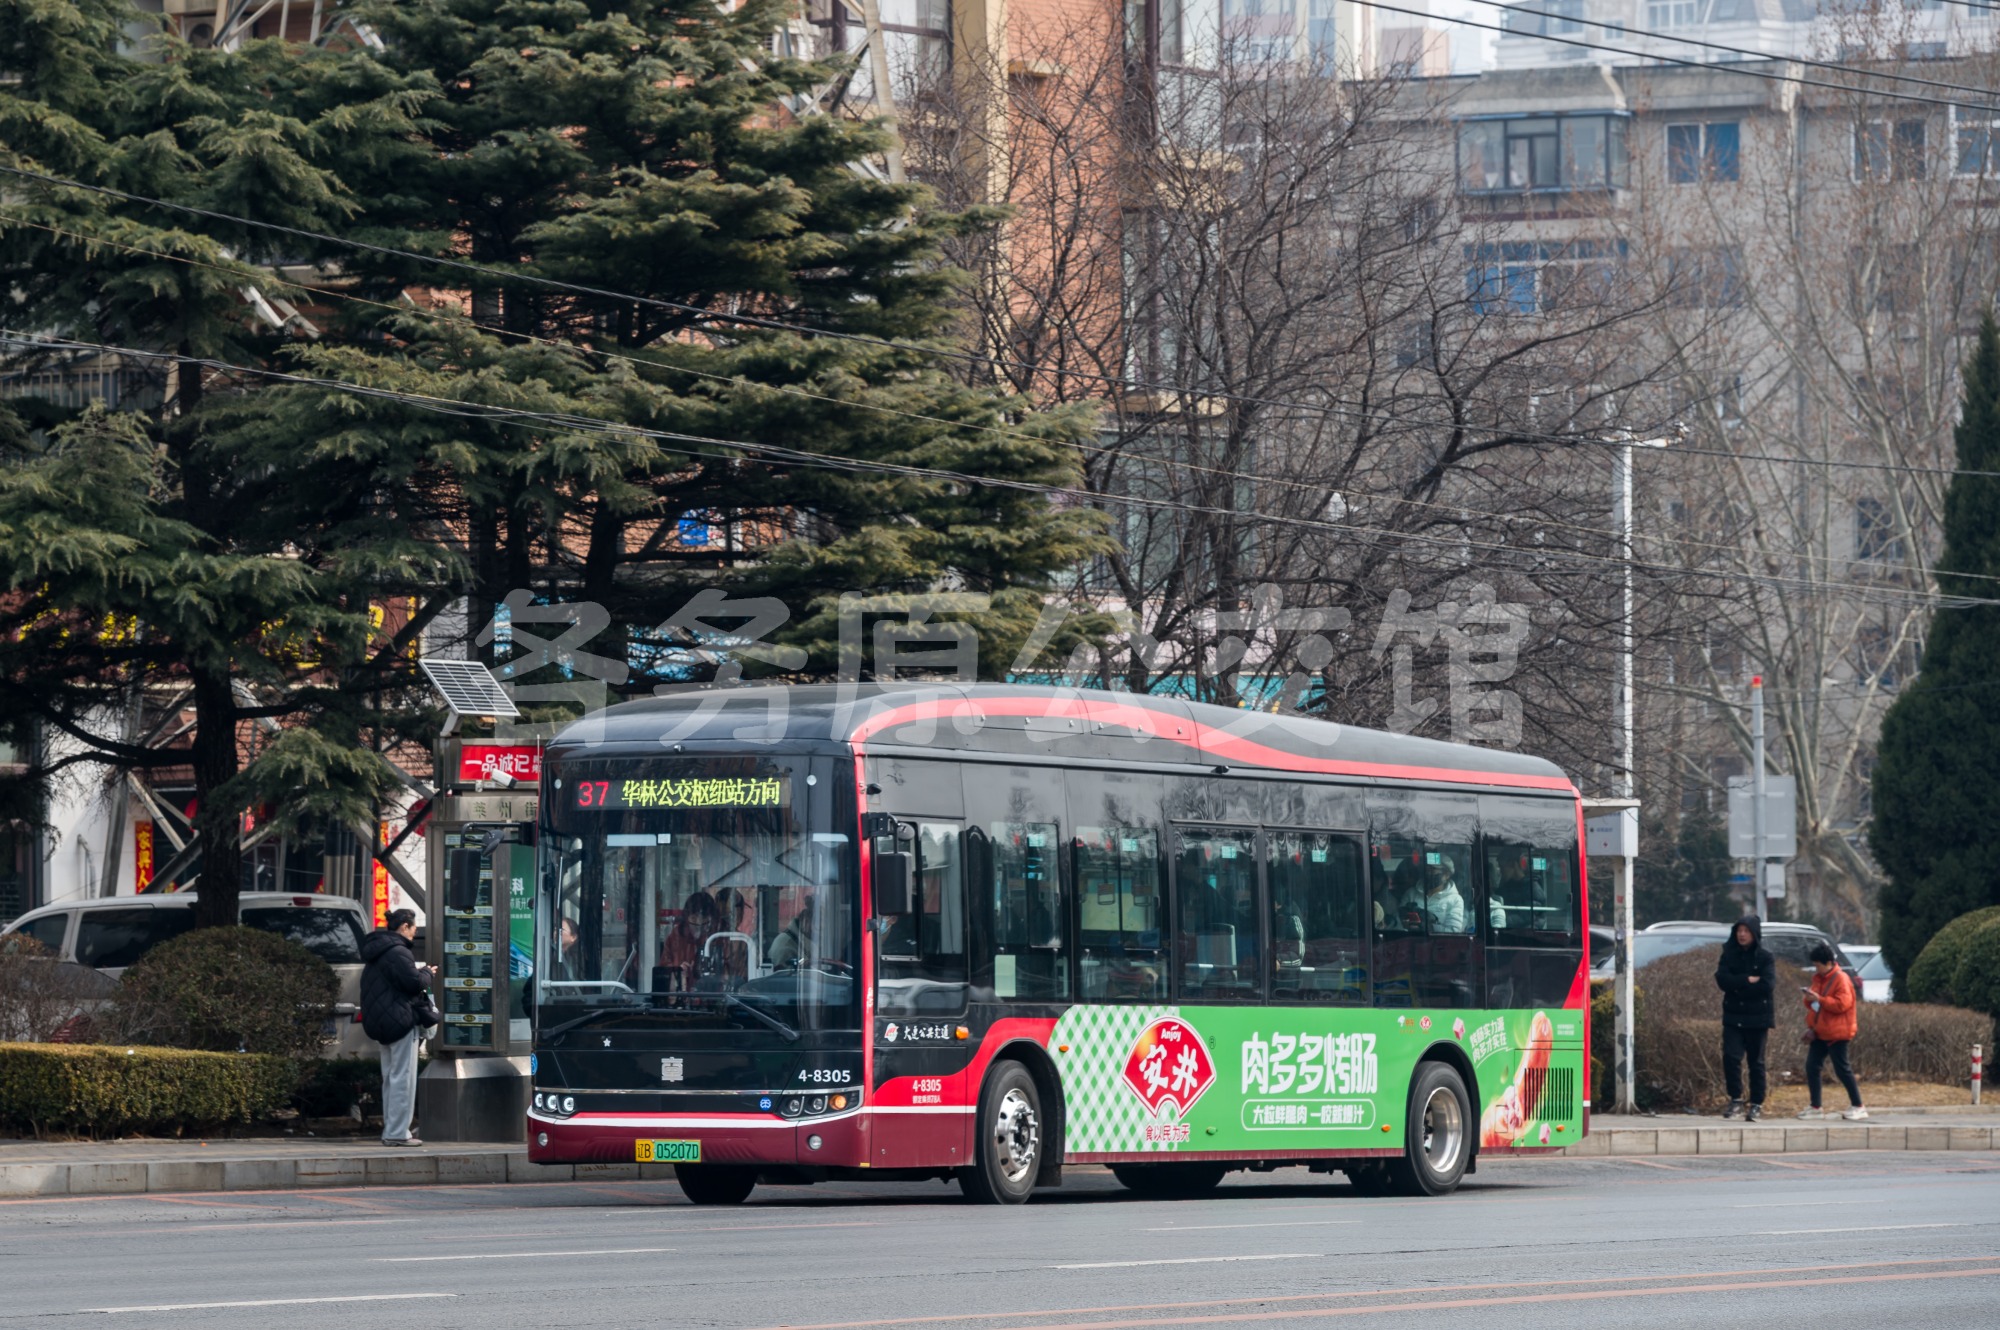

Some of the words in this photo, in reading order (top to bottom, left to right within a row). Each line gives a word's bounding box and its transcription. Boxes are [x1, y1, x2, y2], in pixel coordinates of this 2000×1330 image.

[465, 753, 530, 773] 一品诚记
[578, 781, 609, 806] 37
[621, 778, 780, 807] 华林公交枢纽站方向
[1161, 1024, 1182, 1042] Anjoy
[1139, 1044, 1199, 1099] 安井
[1241, 1031, 1378, 1094] 肉多多烤肠
[798, 1069, 851, 1083] 4-8305
[912, 1079, 942, 1092] 4-8305
[1310, 1105, 1365, 1124] 一咬就爆汁
[1145, 1123, 1190, 1142] 食以民为天
[656, 1142, 699, 1160] 05207D
